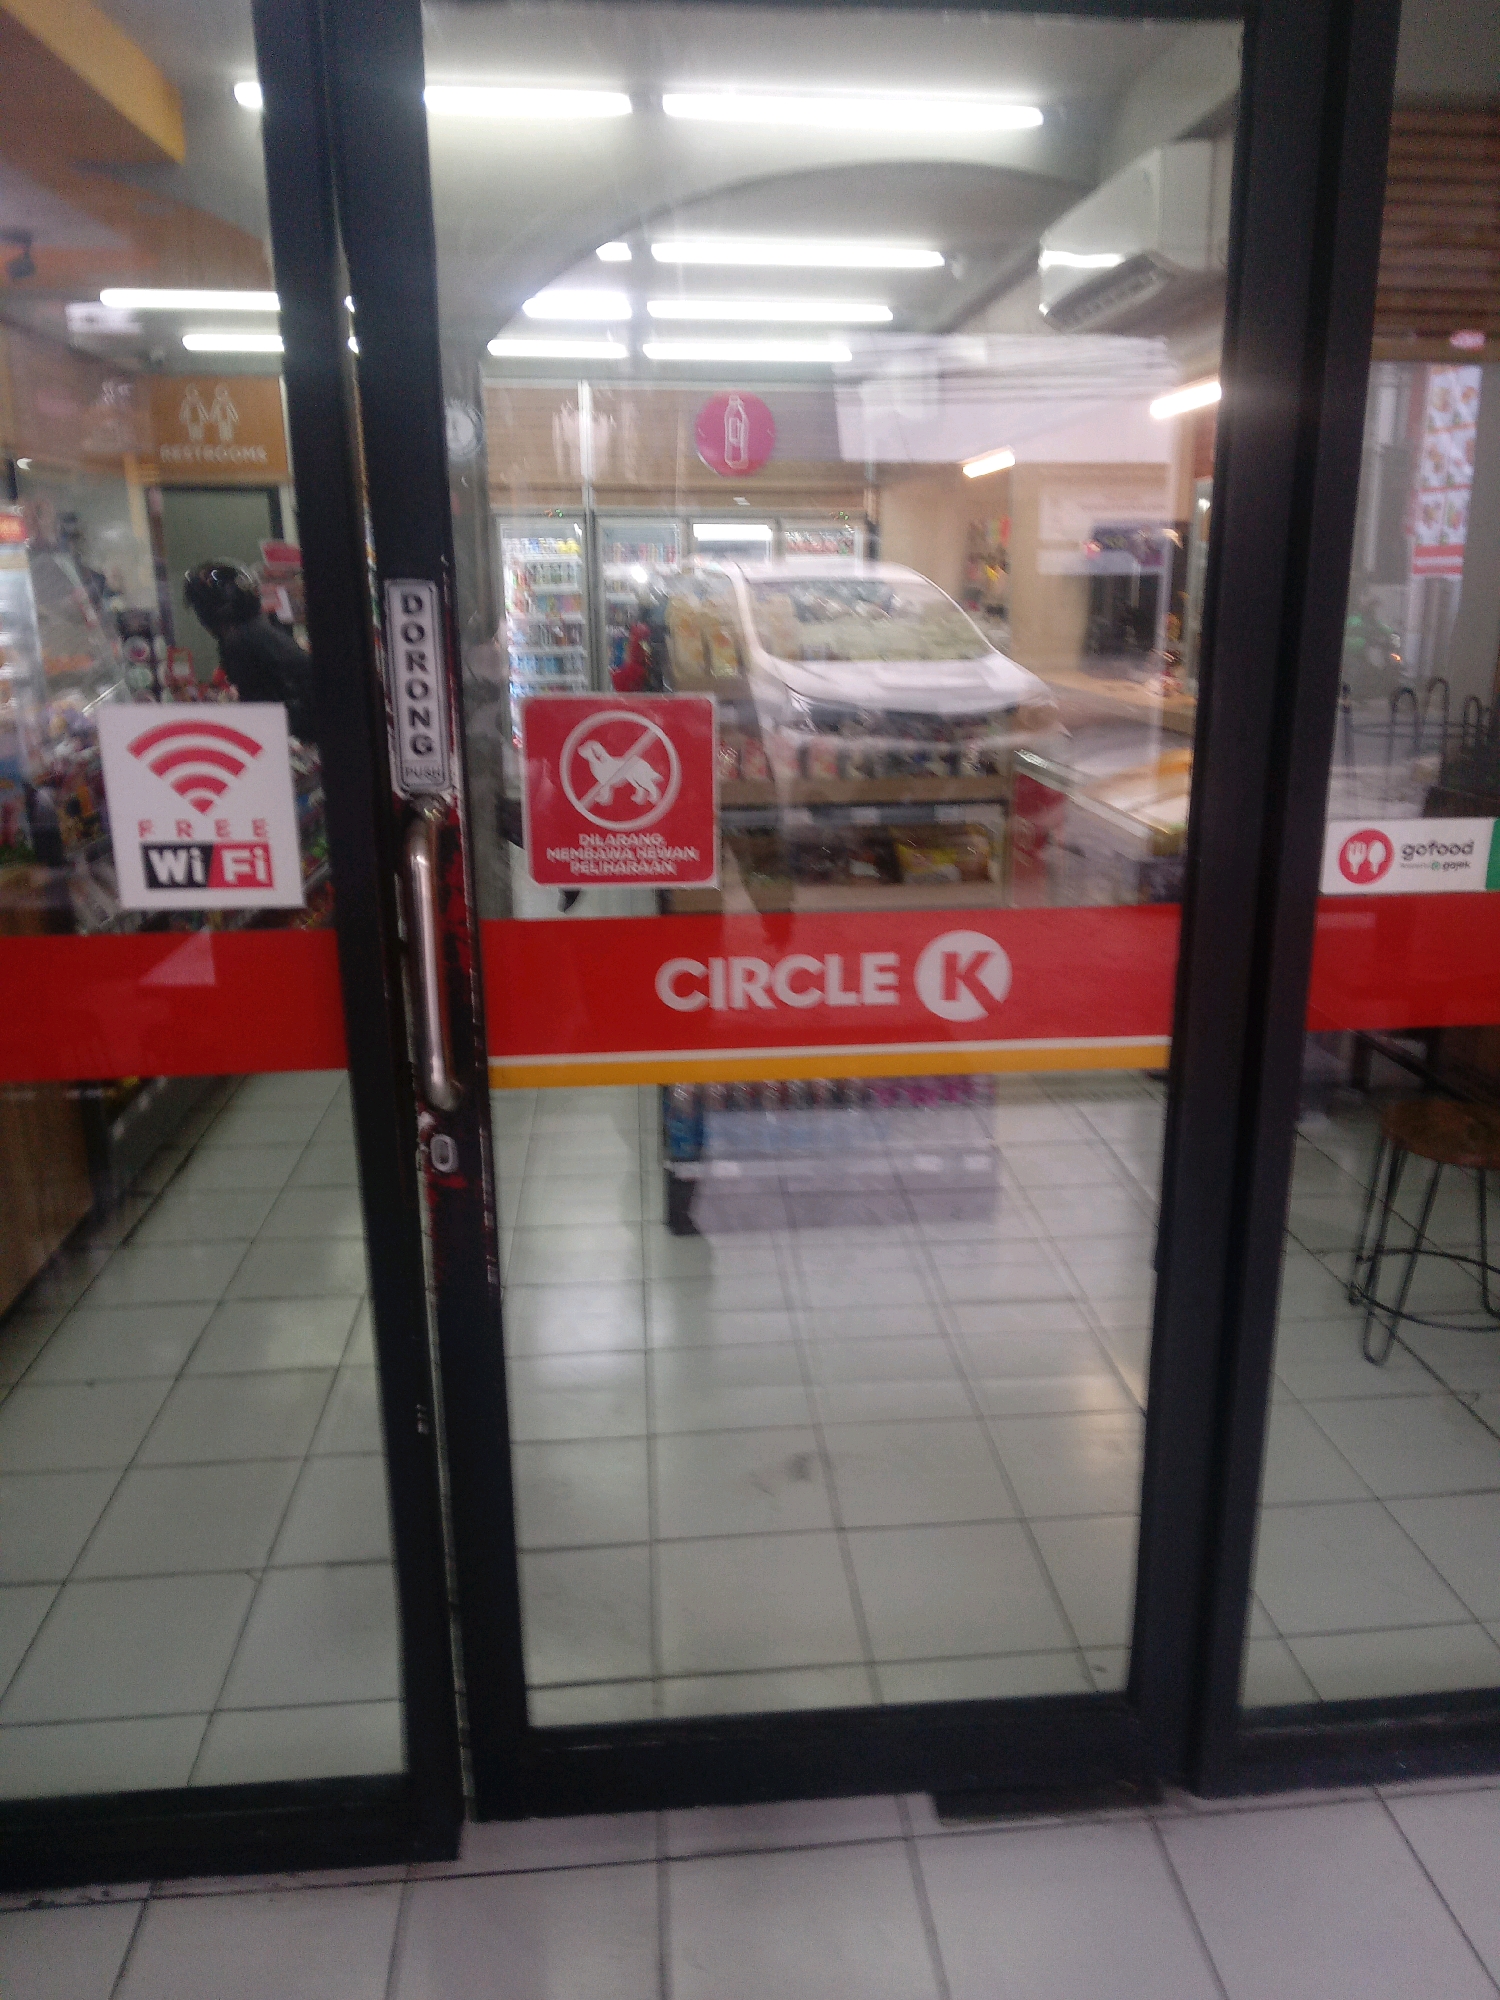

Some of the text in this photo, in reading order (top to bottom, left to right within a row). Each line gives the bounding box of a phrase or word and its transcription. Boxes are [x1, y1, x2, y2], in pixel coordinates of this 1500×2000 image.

[160, 445, 267, 462] RESTROOMS
[401, 592, 433, 757] DORONG
[138, 818, 268, 839] FREE
[578, 832, 668, 847] DILARANG
[546, 845, 700, 862] MEMBAWA HEWAN
[1401, 840, 1475, 861] gofood
[570, 860, 677, 876] PELIHARAAN
[654, 952, 901, 1013] CIRCLE
